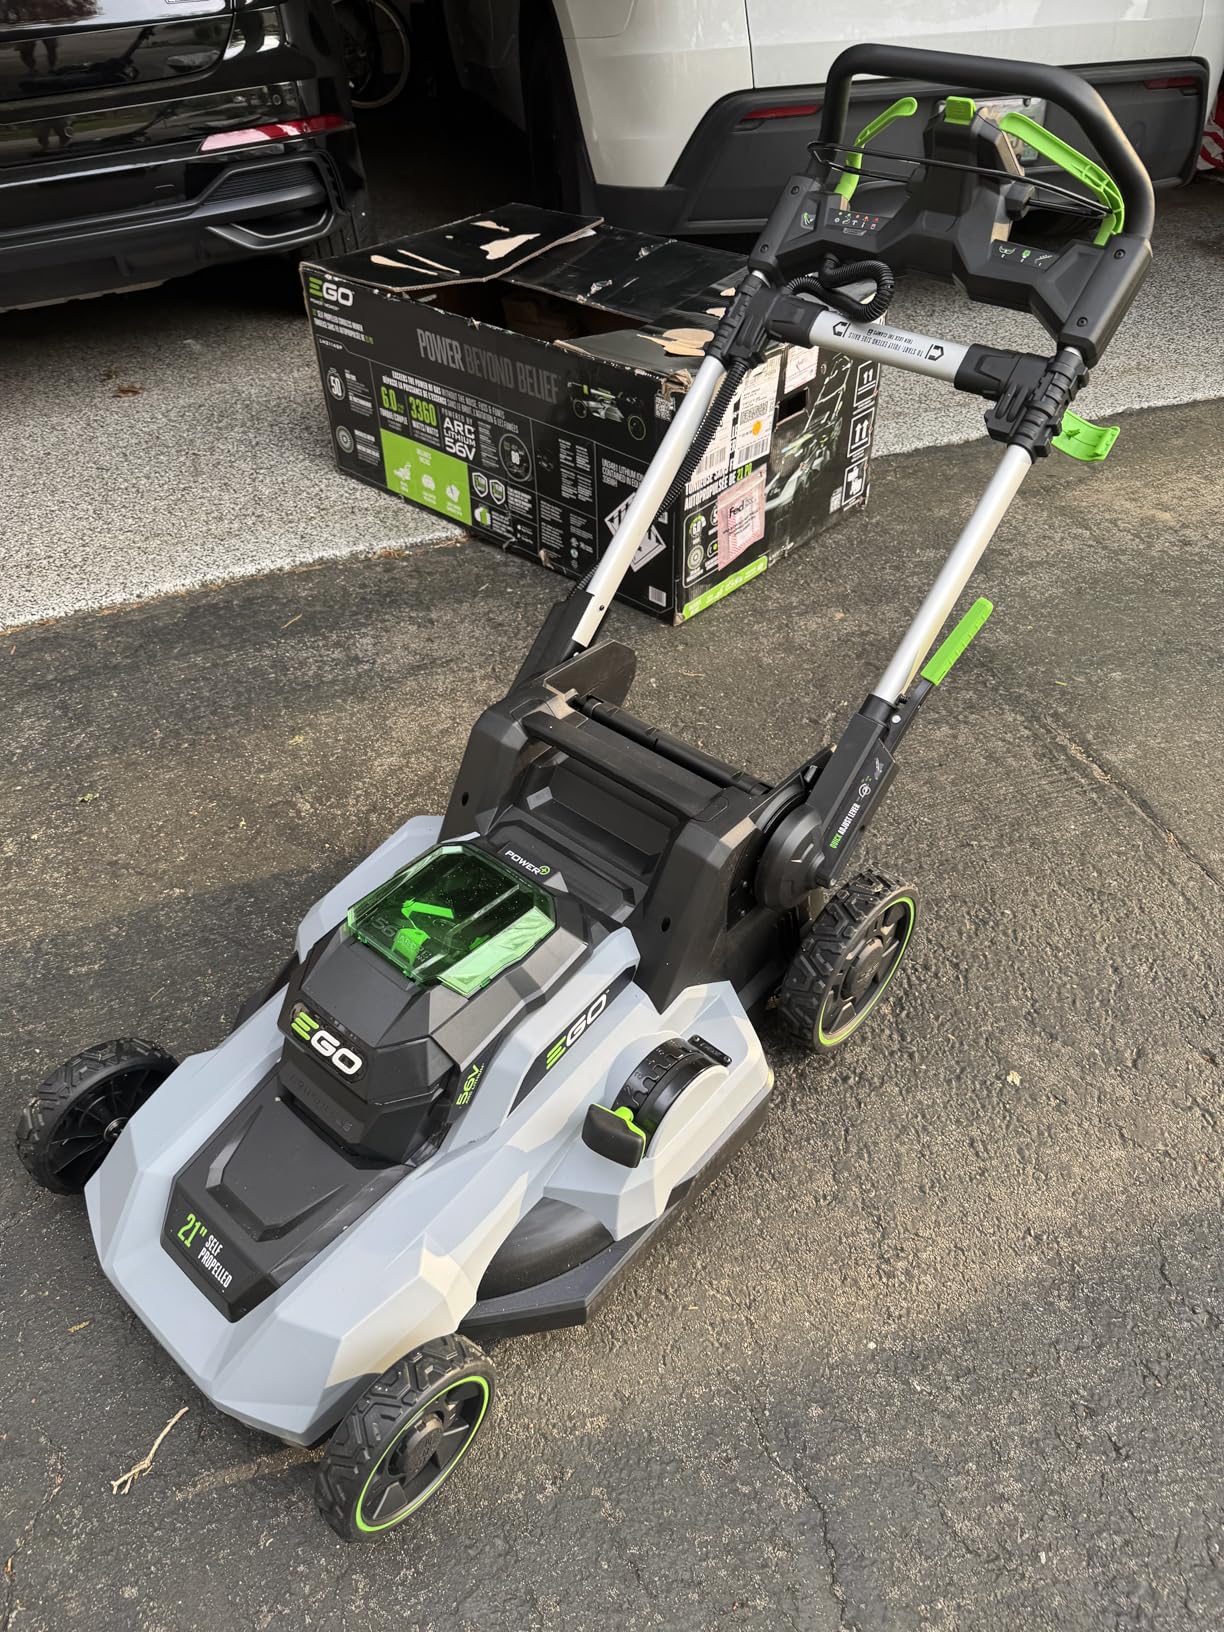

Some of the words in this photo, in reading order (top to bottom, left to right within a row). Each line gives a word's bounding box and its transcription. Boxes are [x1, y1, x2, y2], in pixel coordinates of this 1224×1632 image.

[309, 277, 354, 307] EGO
[416, 328, 465, 372] POWER
[464, 343, 515, 390] BEYOND
[516, 361, 560, 405] BELIEF
[330, 375, 343, 397] 50
[381, 386, 397, 412] 6.0
[408, 396, 437, 427] 3360
[443, 416, 476, 440] ARC
[444, 428, 476, 448] LITHIUM
[444, 437, 476, 461] 56V
[618, 464, 636, 479] LITHIUM
[736, 467, 744, 481] 21
[837, 815, 852, 835] ADJUST
[848, 803, 861, 819] LEVER
[291, 1011, 363, 1075] EGO
[546, 992, 607, 1071] EGO
[456, 1064, 480, 1105] 56V
[205, 1235, 223, 1257] SELF
[197, 1247, 233, 1288] PROPELLED
